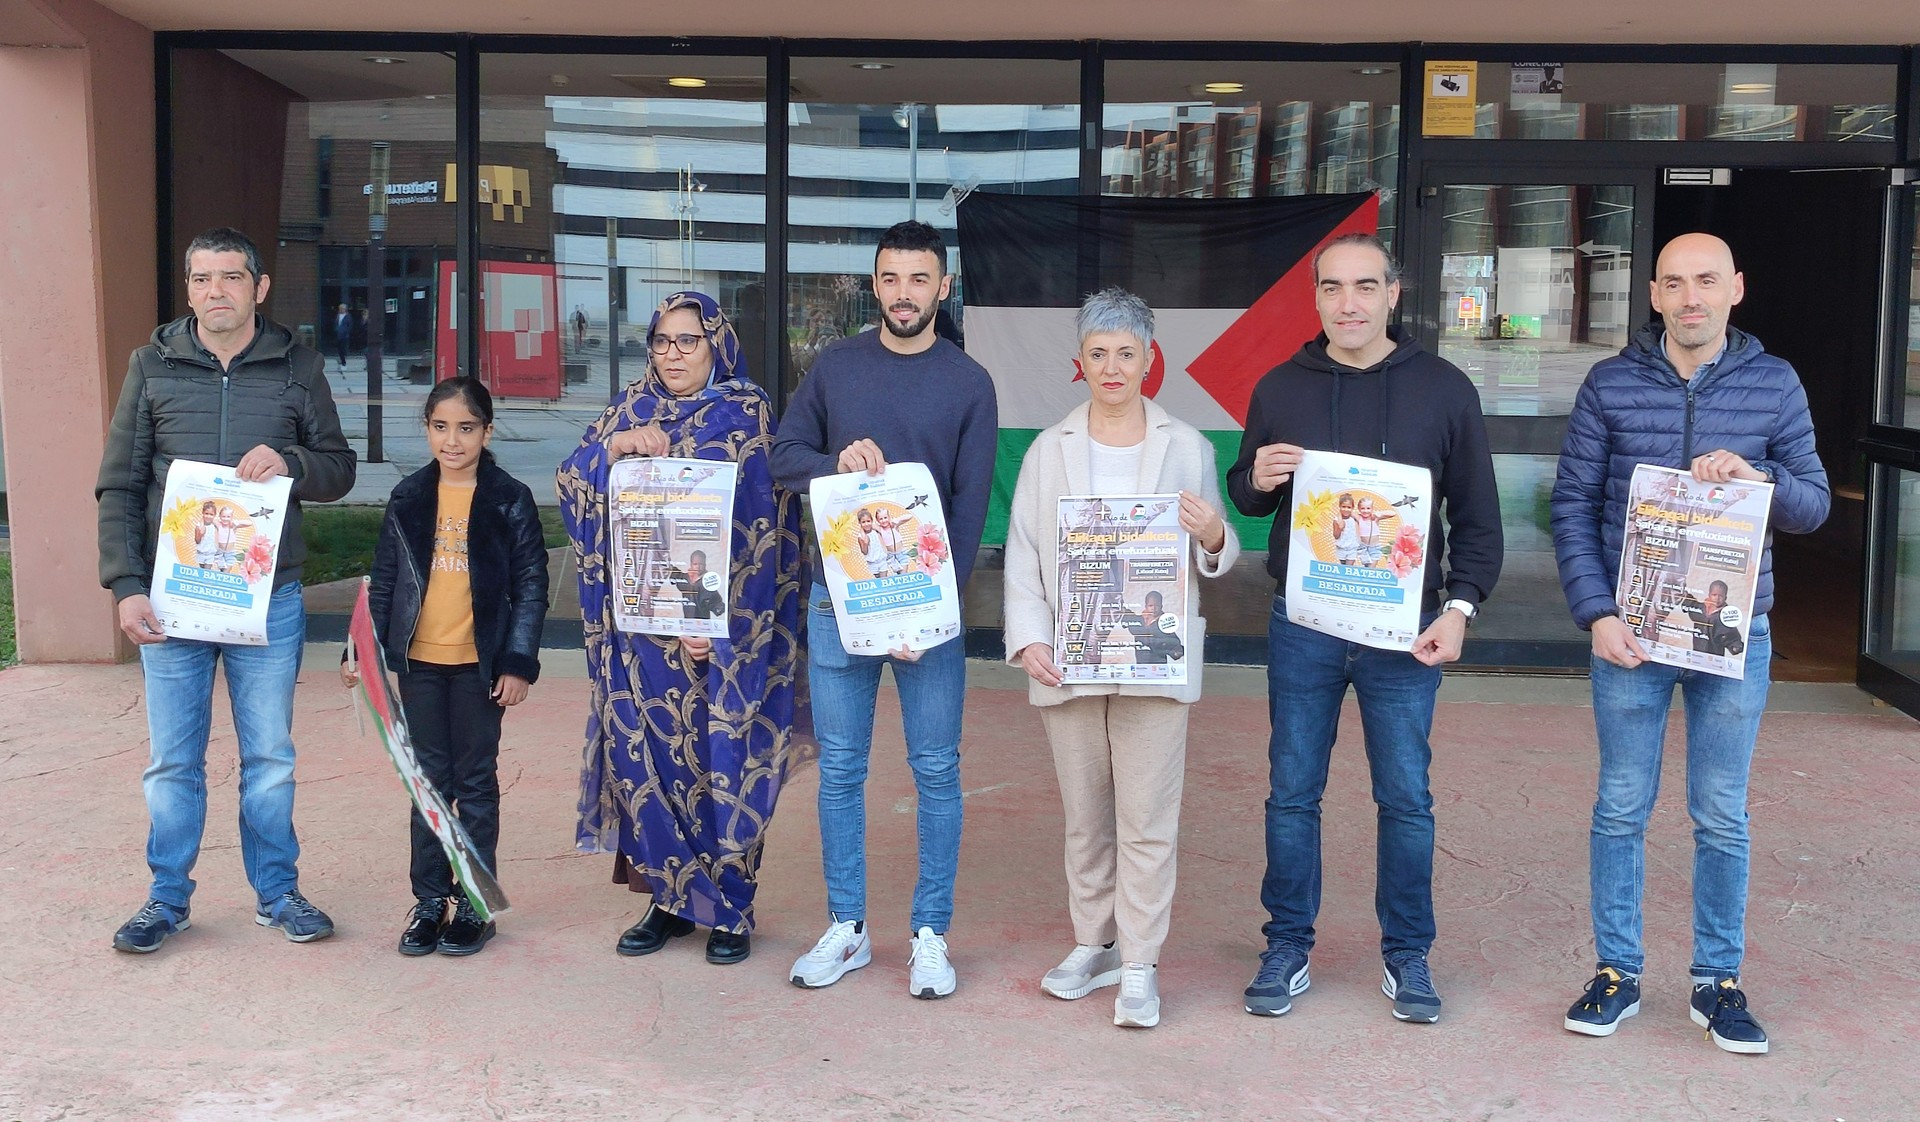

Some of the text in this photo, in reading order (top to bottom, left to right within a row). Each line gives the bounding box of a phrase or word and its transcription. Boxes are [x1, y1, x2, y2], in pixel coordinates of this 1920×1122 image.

[1645, 536, 1679, 549] BIZUM
[179, 566, 243, 585] UDA BATEKO
[1317, 563, 1391, 580] UDA BATEKO
[855, 573, 924, 592] UDA BATEKO
[1318, 580, 1387, 598] BESARKADA
[179, 583, 238, 602] BESARKADA
[860, 590, 925, 609] BESARKADA
